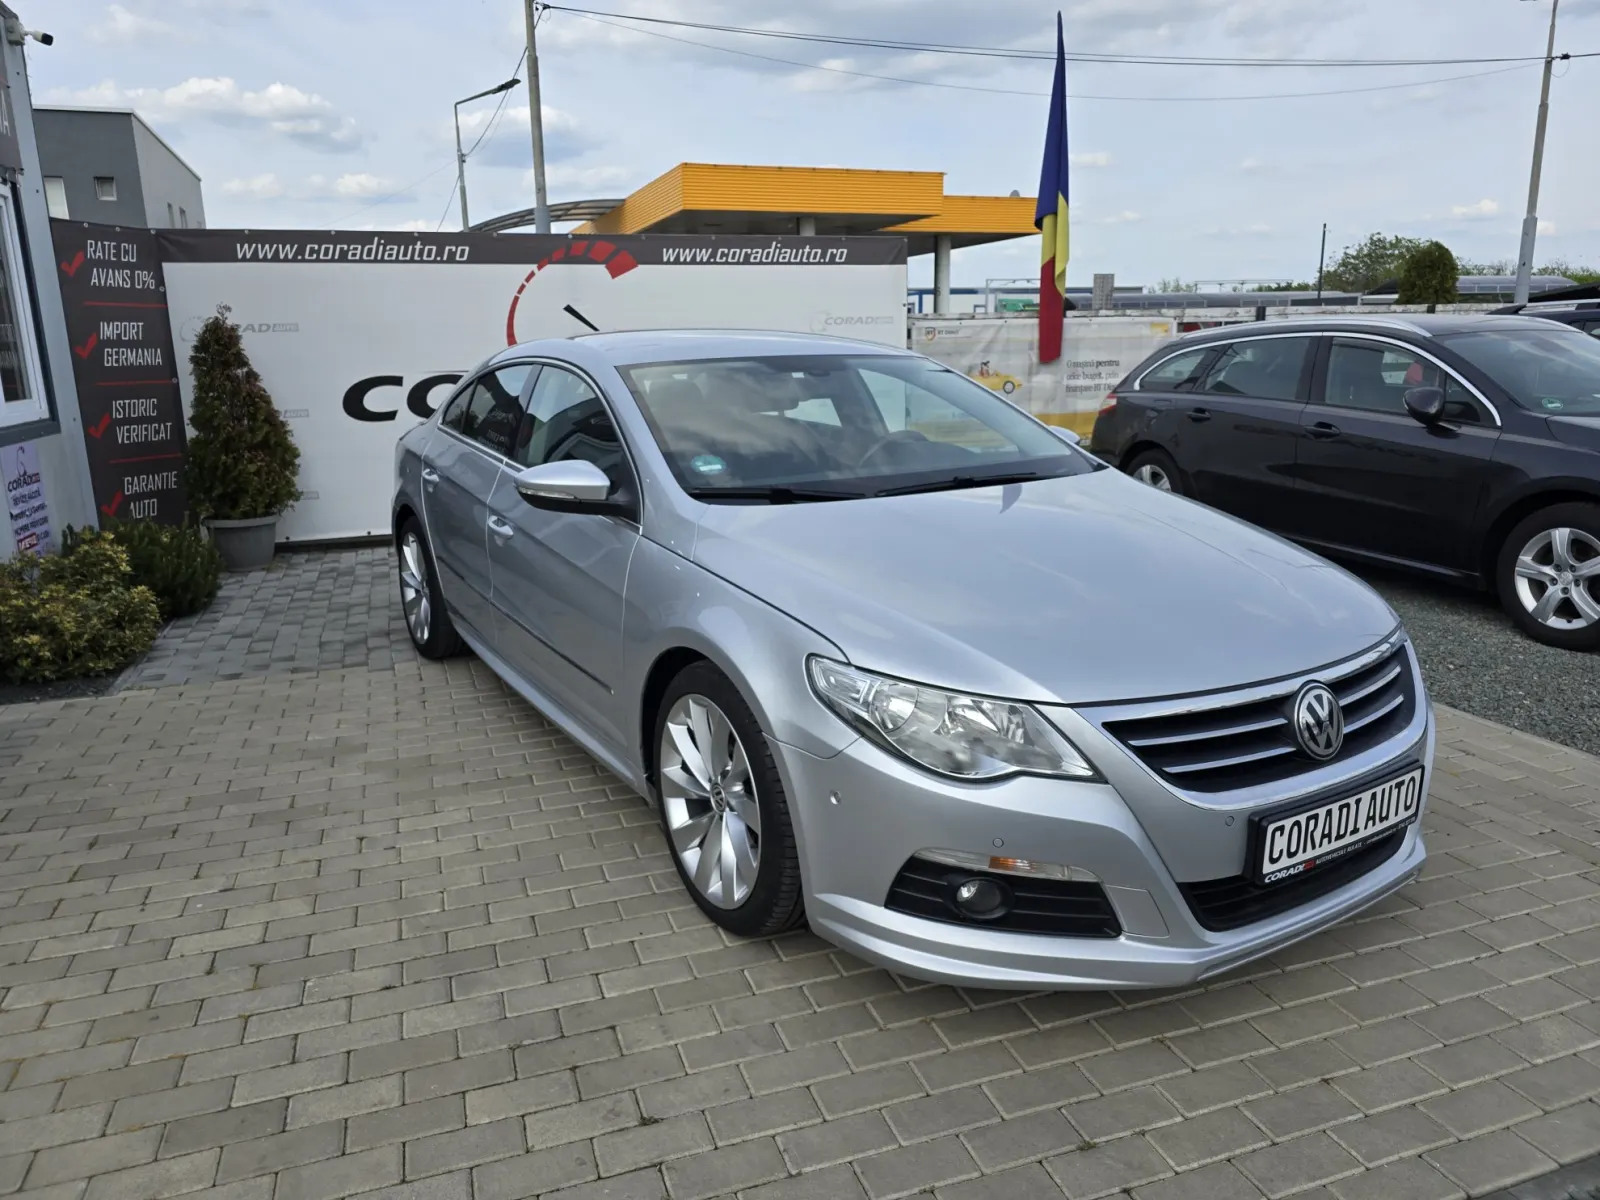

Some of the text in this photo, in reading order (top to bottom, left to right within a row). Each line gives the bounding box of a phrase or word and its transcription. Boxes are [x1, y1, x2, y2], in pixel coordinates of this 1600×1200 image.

[87, 240, 137, 262] RATE CU
[236, 237, 470, 261] www.coradiauto.ro
[662, 241, 848, 263] www.coradiauto.ro
[90, 267, 155, 289] AVANS 0%
[99, 321, 144, 340] IMPORT
[104, 348, 162, 367] GERMANIA
[1095, 359, 1120, 369] pentru
[112, 398, 157, 419] ISTORIC
[116, 422, 172, 445] VERIFICAT
[124, 471, 178, 495] GARANTIE
[129, 498, 158, 519] AUTO
[1268, 775, 1416, 865] CORADI AUTO
